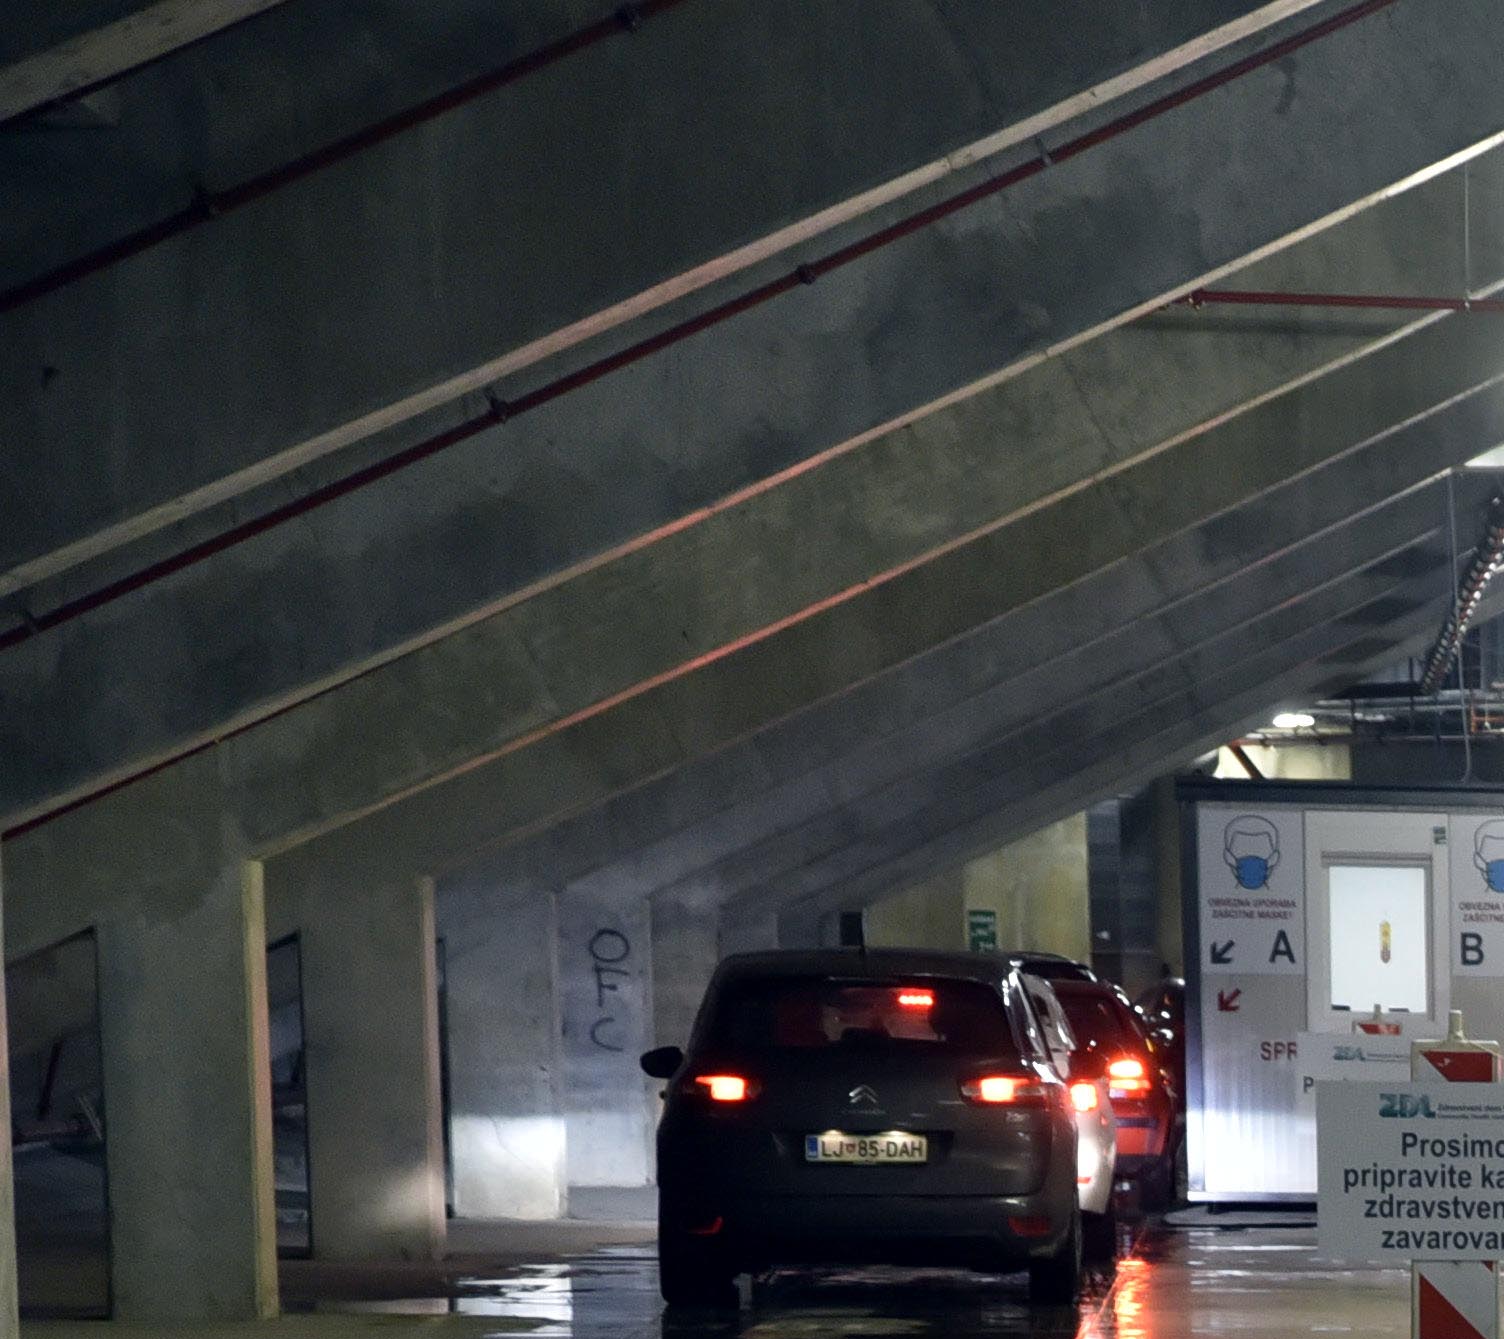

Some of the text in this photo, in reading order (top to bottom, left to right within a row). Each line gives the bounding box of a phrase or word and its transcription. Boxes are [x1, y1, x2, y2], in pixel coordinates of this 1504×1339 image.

[1268, 929, 1296, 964] A
[1460, 932, 1485, 967] B
[1343, 1162, 1472, 1193] pripravite
